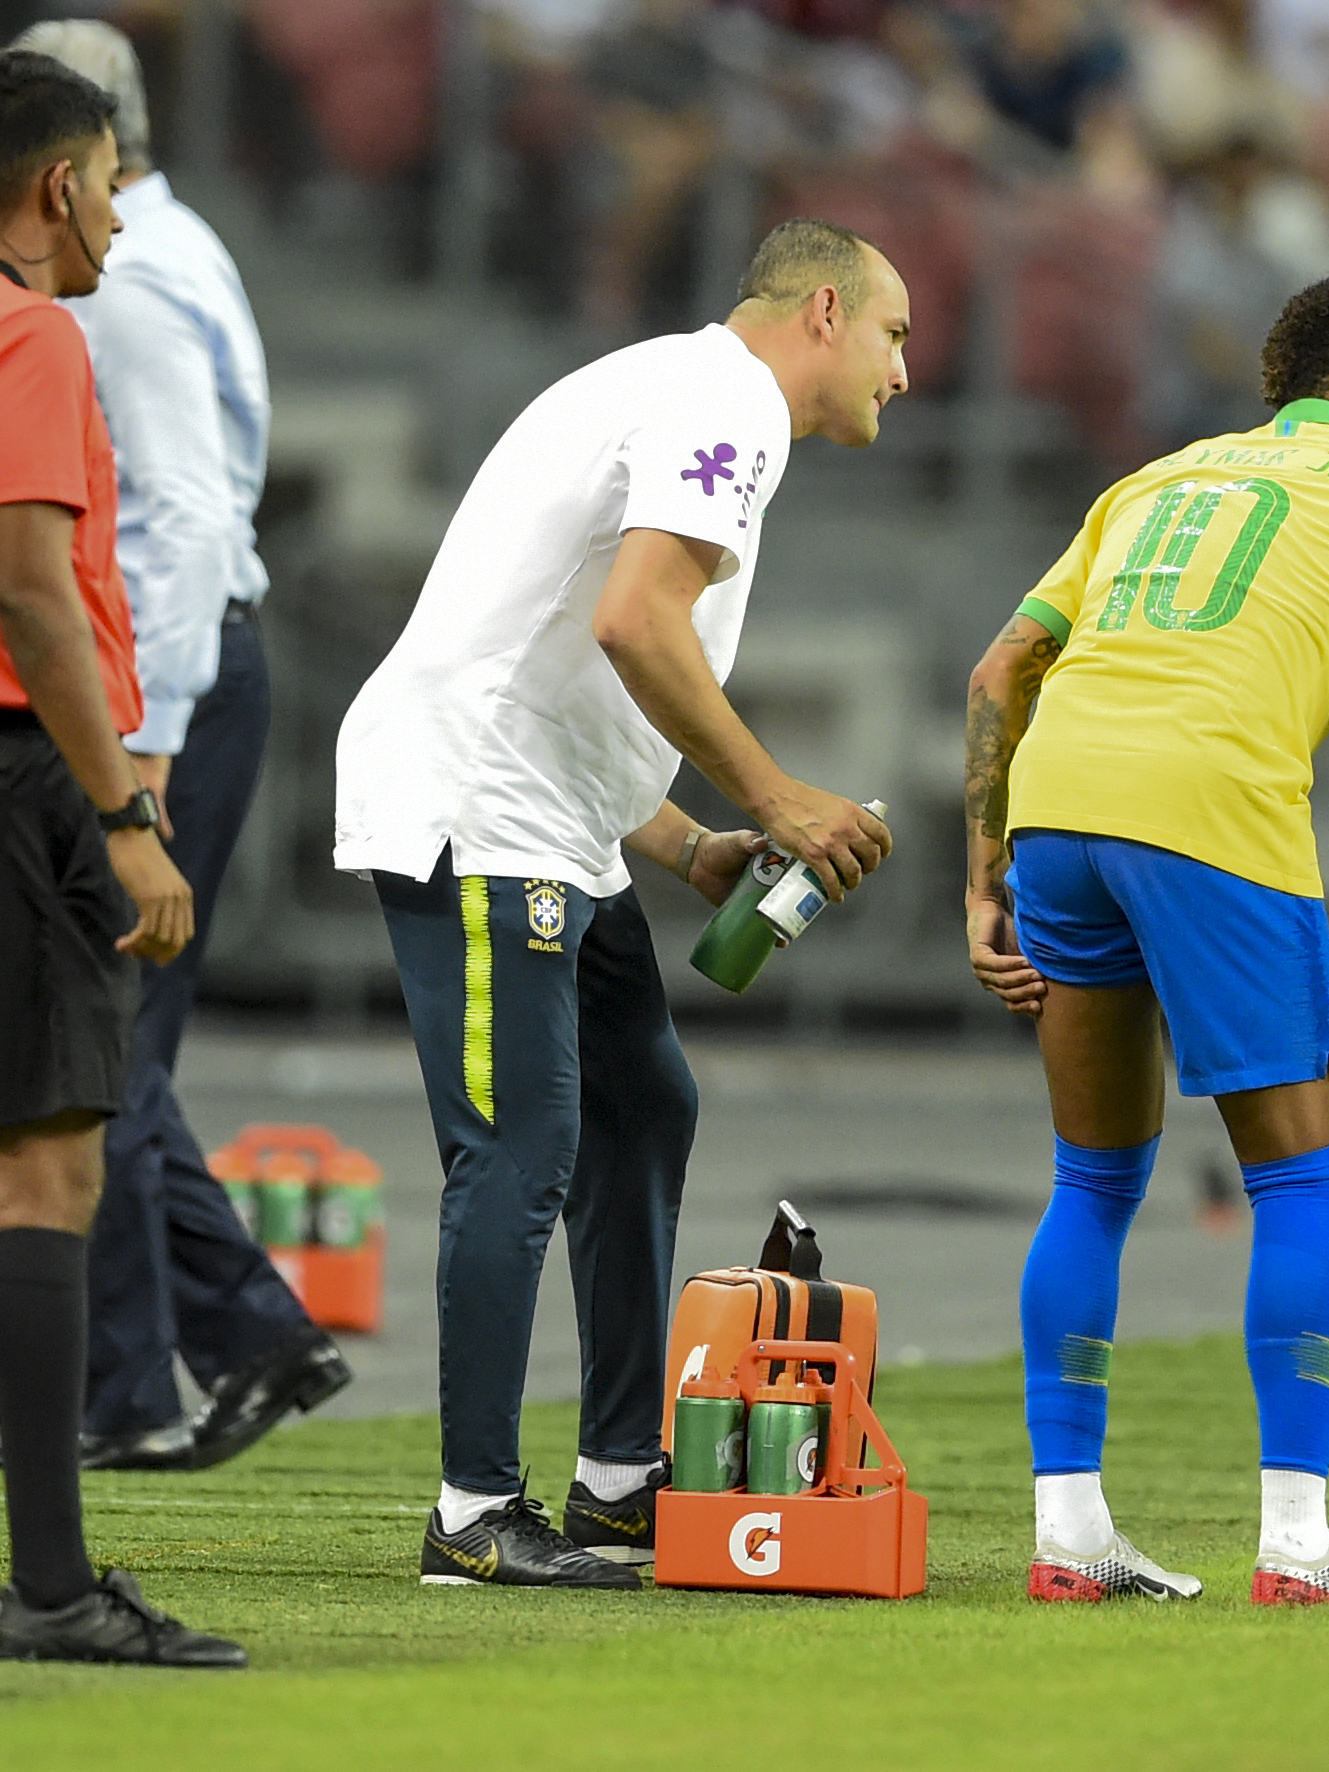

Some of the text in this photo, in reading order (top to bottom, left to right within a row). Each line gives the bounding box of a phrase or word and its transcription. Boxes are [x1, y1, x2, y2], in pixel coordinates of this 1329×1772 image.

[1095, 476, 1291, 633] 10
[527, 938, 564, 953] BRASIL
[728, 1511, 782, 1577] G
